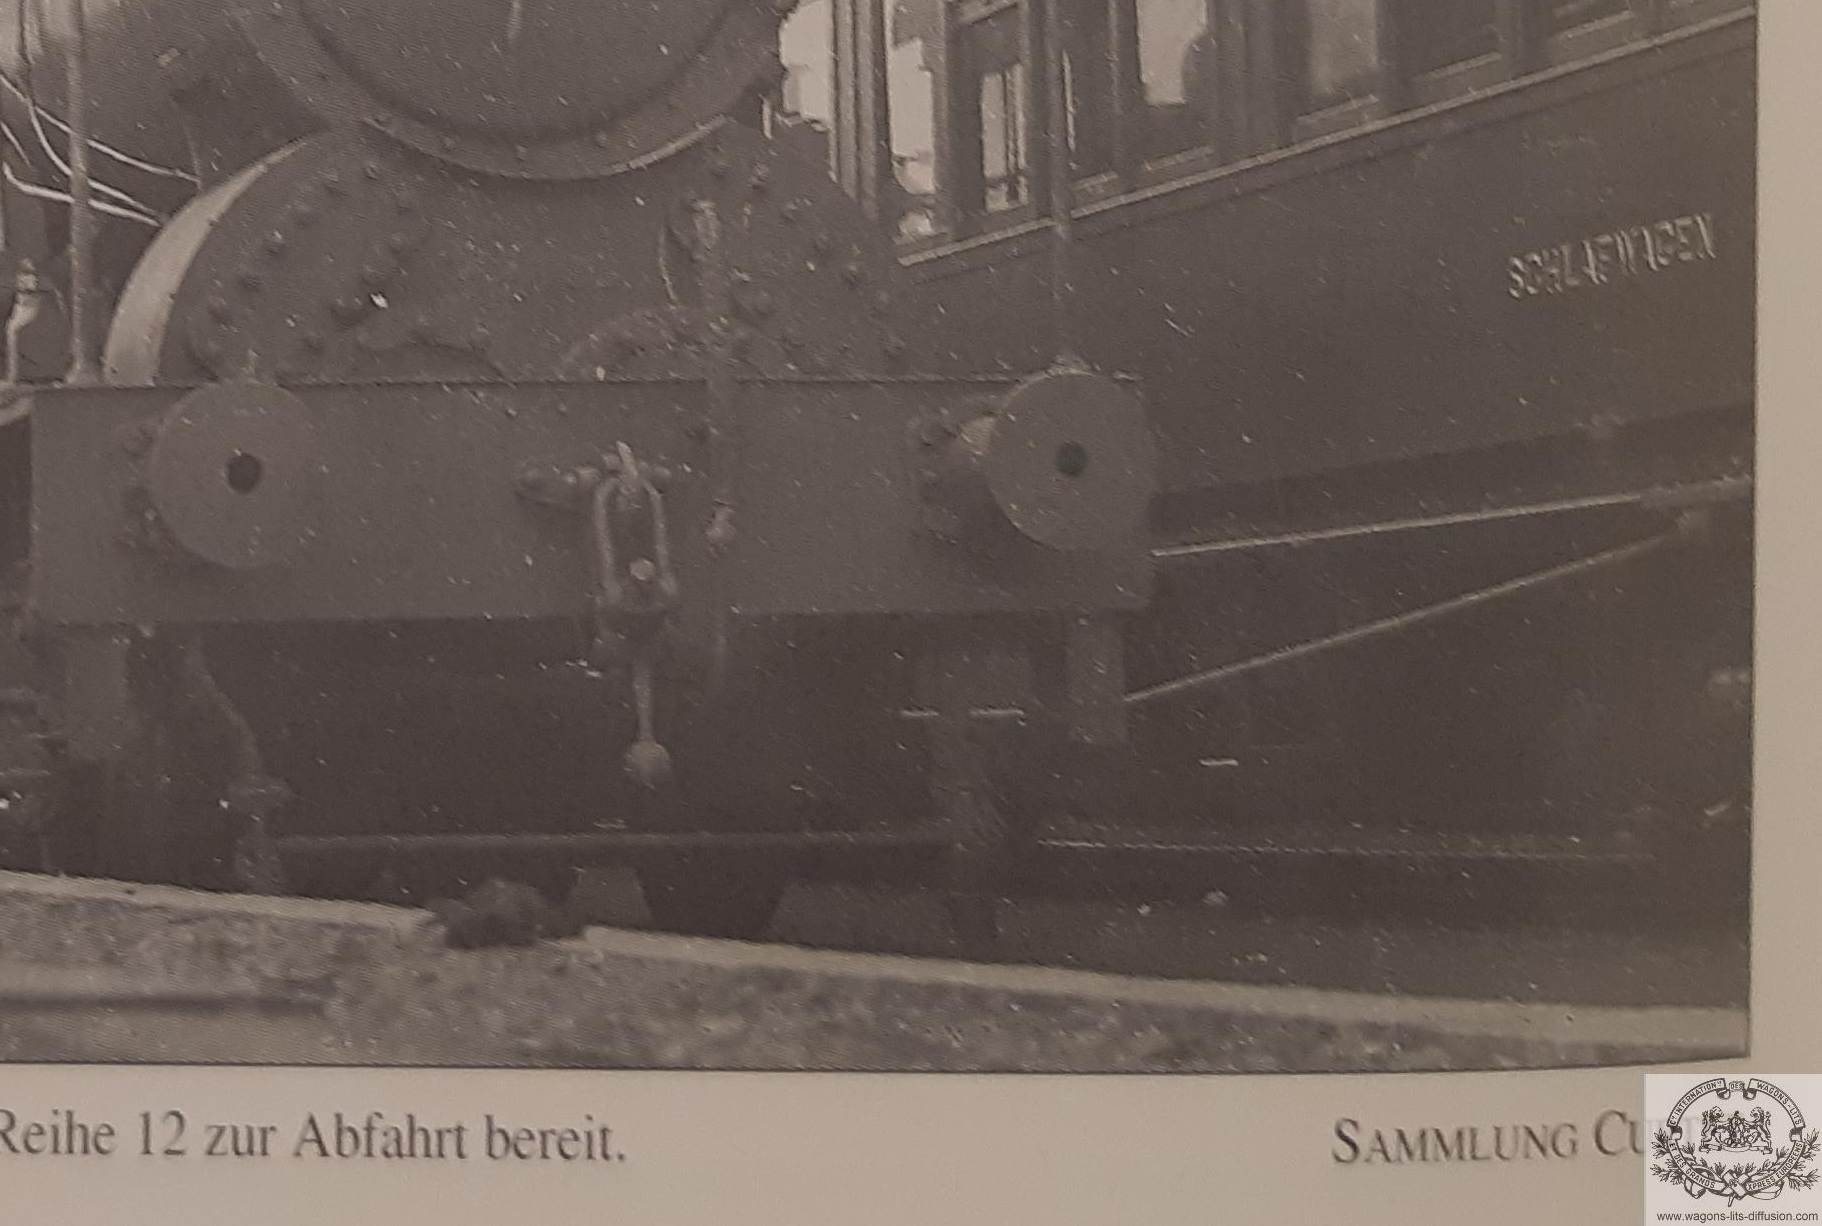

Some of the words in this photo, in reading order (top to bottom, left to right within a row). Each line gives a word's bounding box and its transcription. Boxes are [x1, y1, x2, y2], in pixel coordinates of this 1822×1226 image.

[1506, 212, 1718, 301] SCHLAFWAGEN
[138, 1109, 188, 1157] 12
[204, 1123, 277, 1158] zur
[292, 1112, 468, 1160] Abfahrt
[485, 1114, 626, 1162] bereit.
